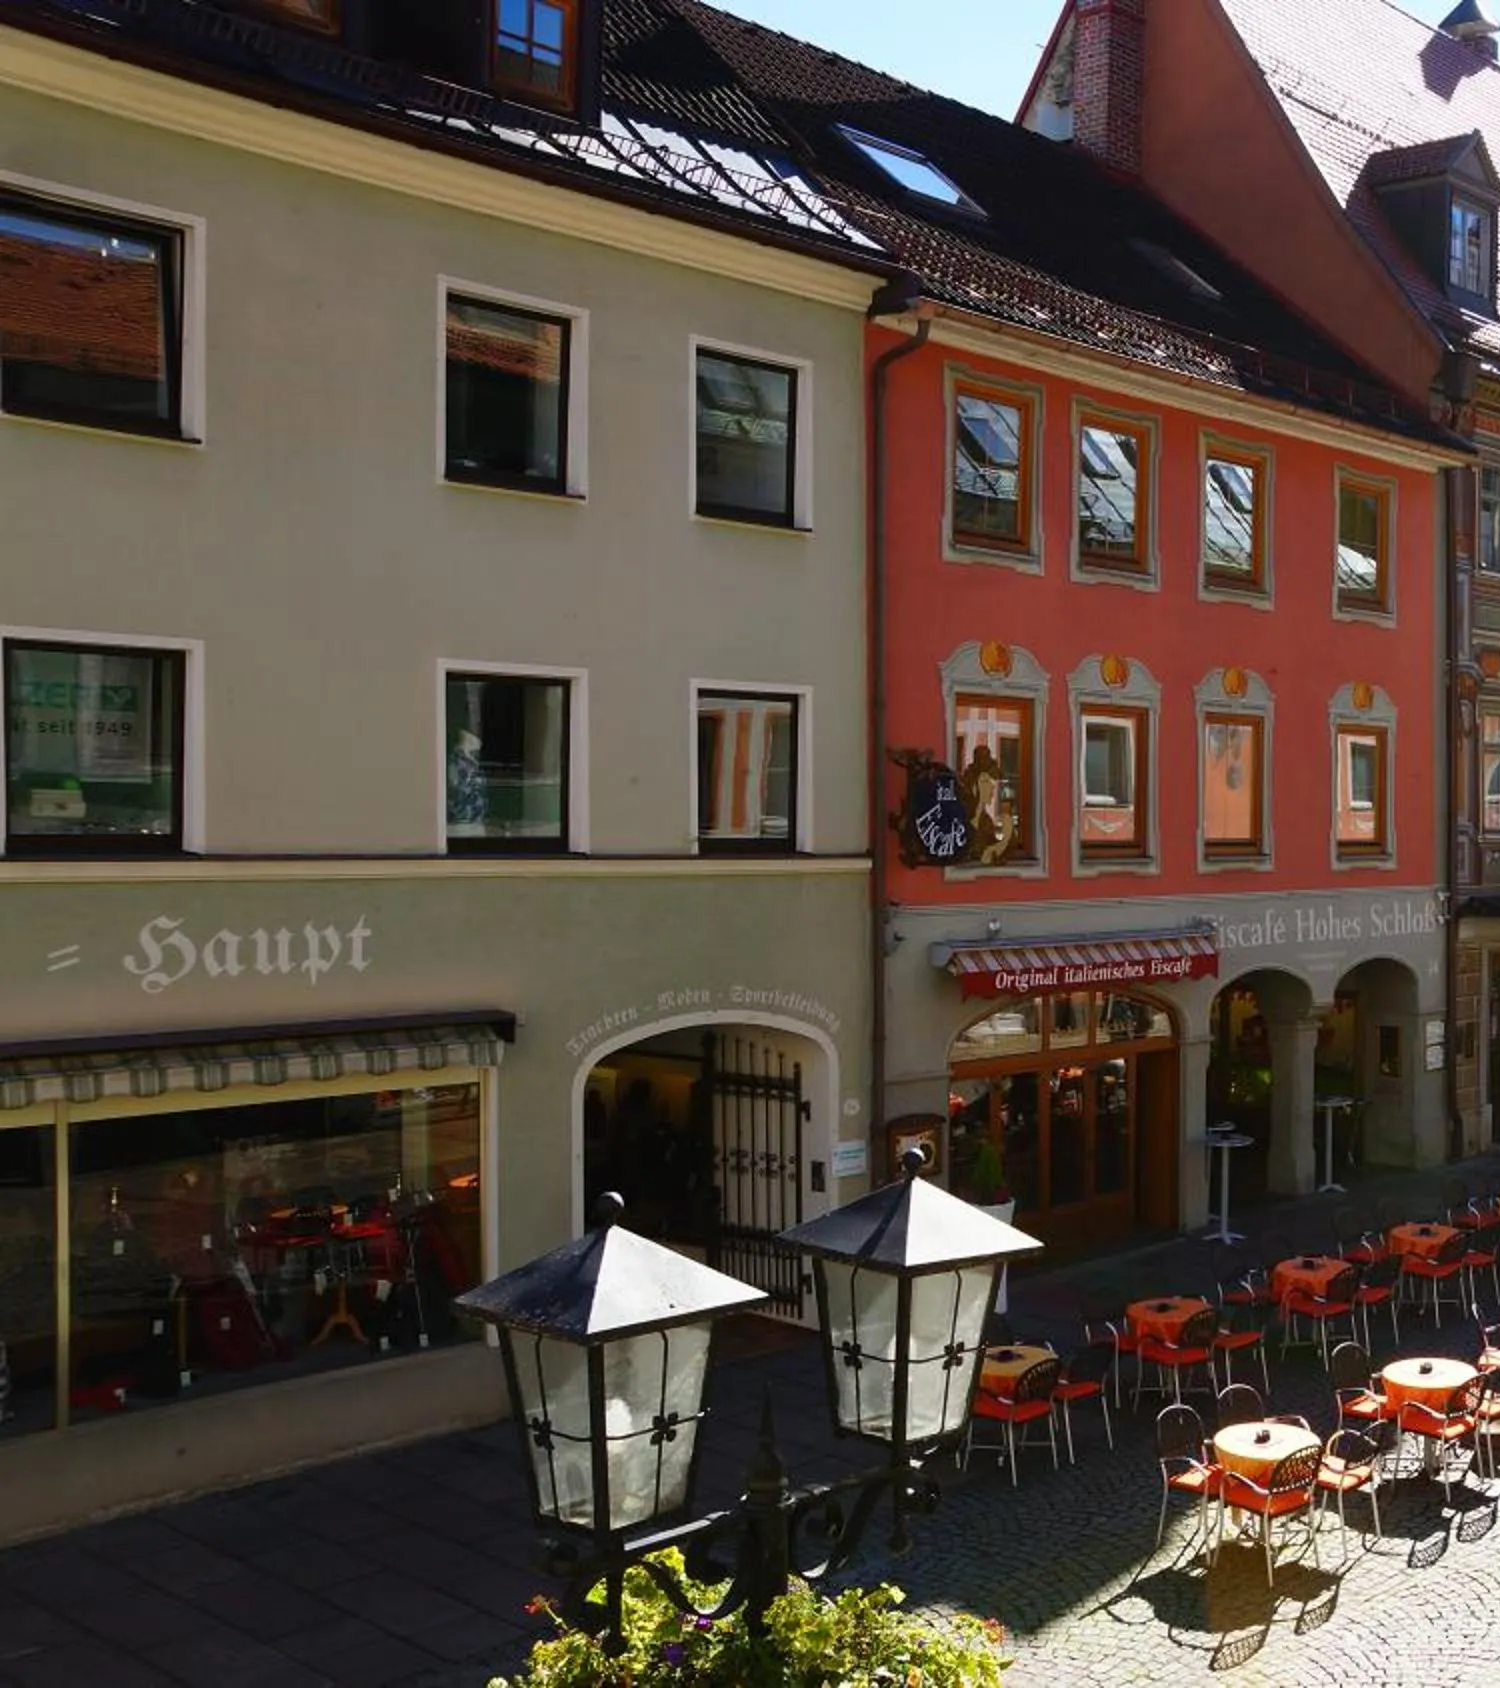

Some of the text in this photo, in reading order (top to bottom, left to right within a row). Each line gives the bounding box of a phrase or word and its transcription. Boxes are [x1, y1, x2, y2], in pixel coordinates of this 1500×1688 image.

[38, 720, 76, 736] seit
[86, 721, 132, 736] 1949
[1209, 900, 1436, 950] iscafé Hohes Schloß
[123, 912, 373, 993] Haupt
[995, 966, 1058, 993] Original
[1065, 961, 1145, 985] italienisches
[565, 1007, 638, 1057] Trachten
[657, 989, 712, 1011] Moden
